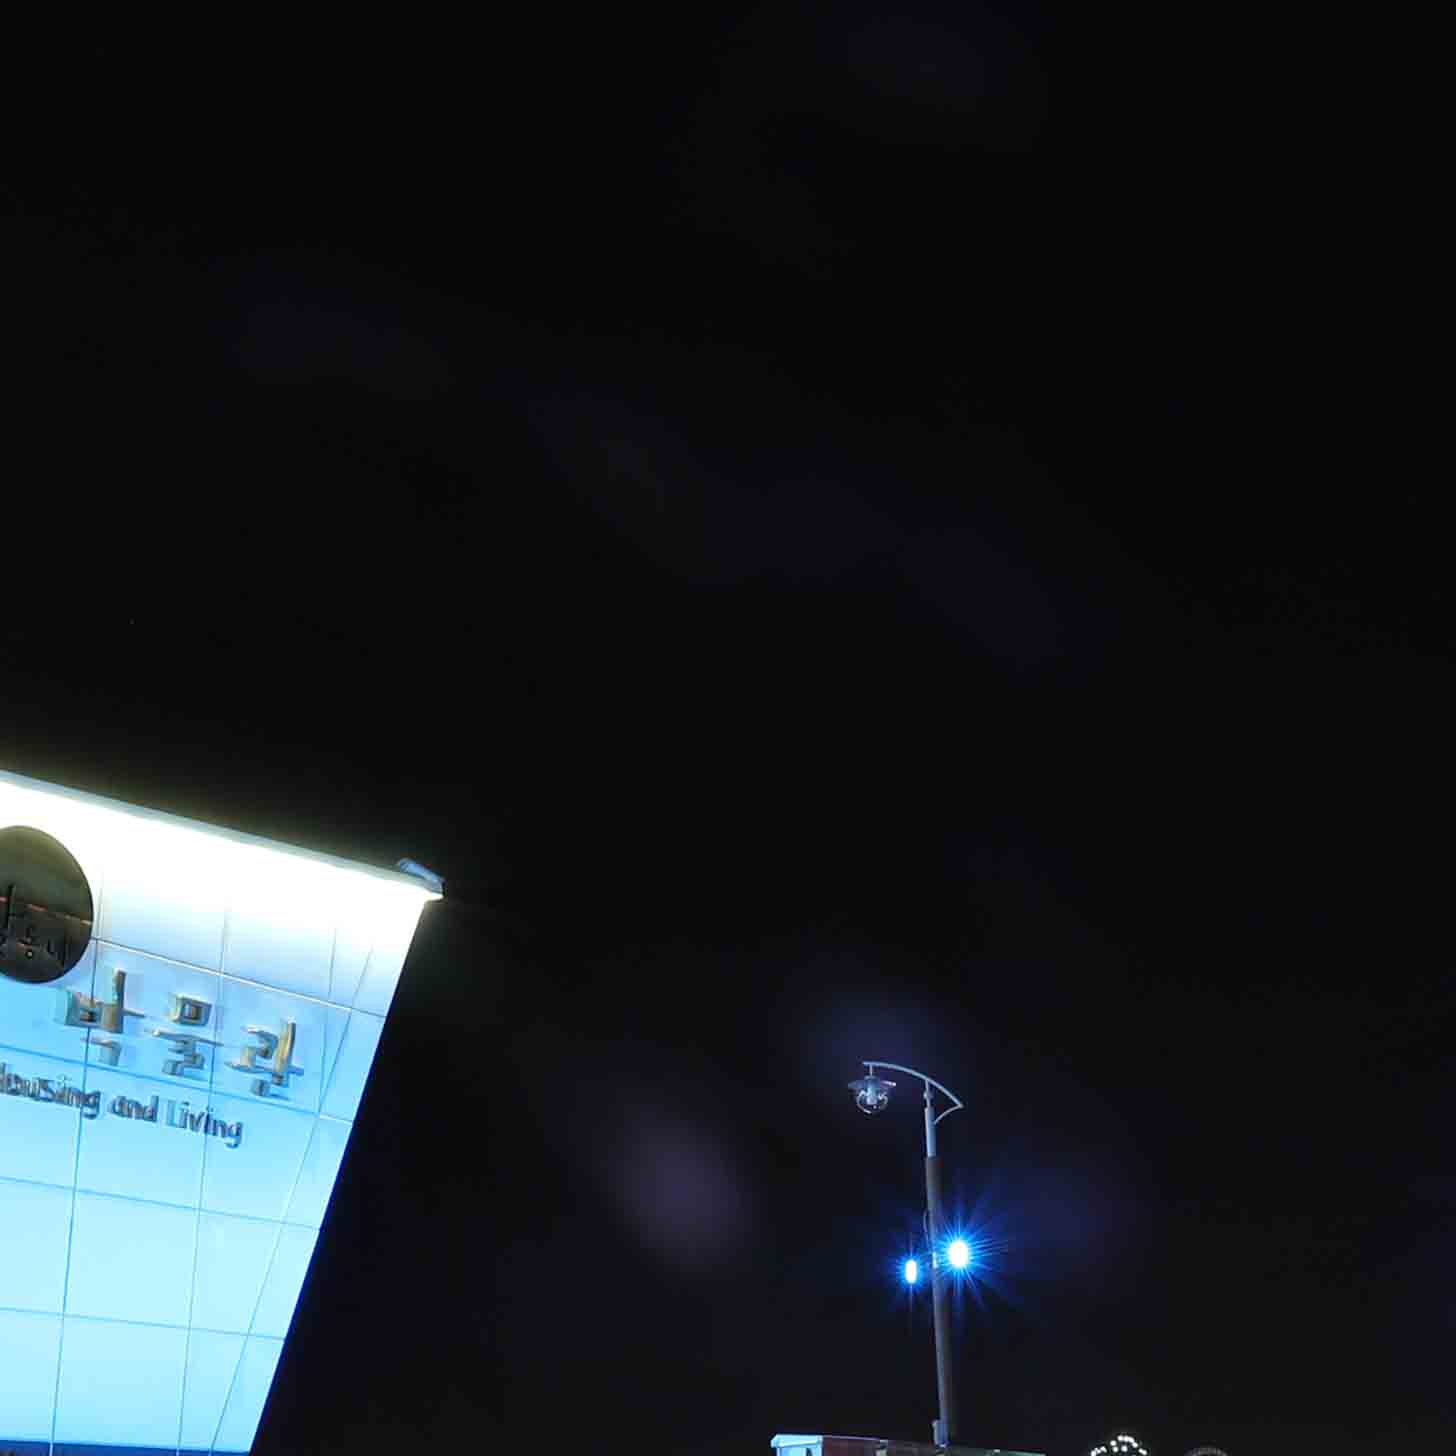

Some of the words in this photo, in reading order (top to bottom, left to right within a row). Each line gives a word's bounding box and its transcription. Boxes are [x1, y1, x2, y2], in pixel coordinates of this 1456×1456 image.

[63, 970, 304, 1100] 박물관
[107, 1094, 160, 1123] and
[166, 1097, 244, 1148] Living
